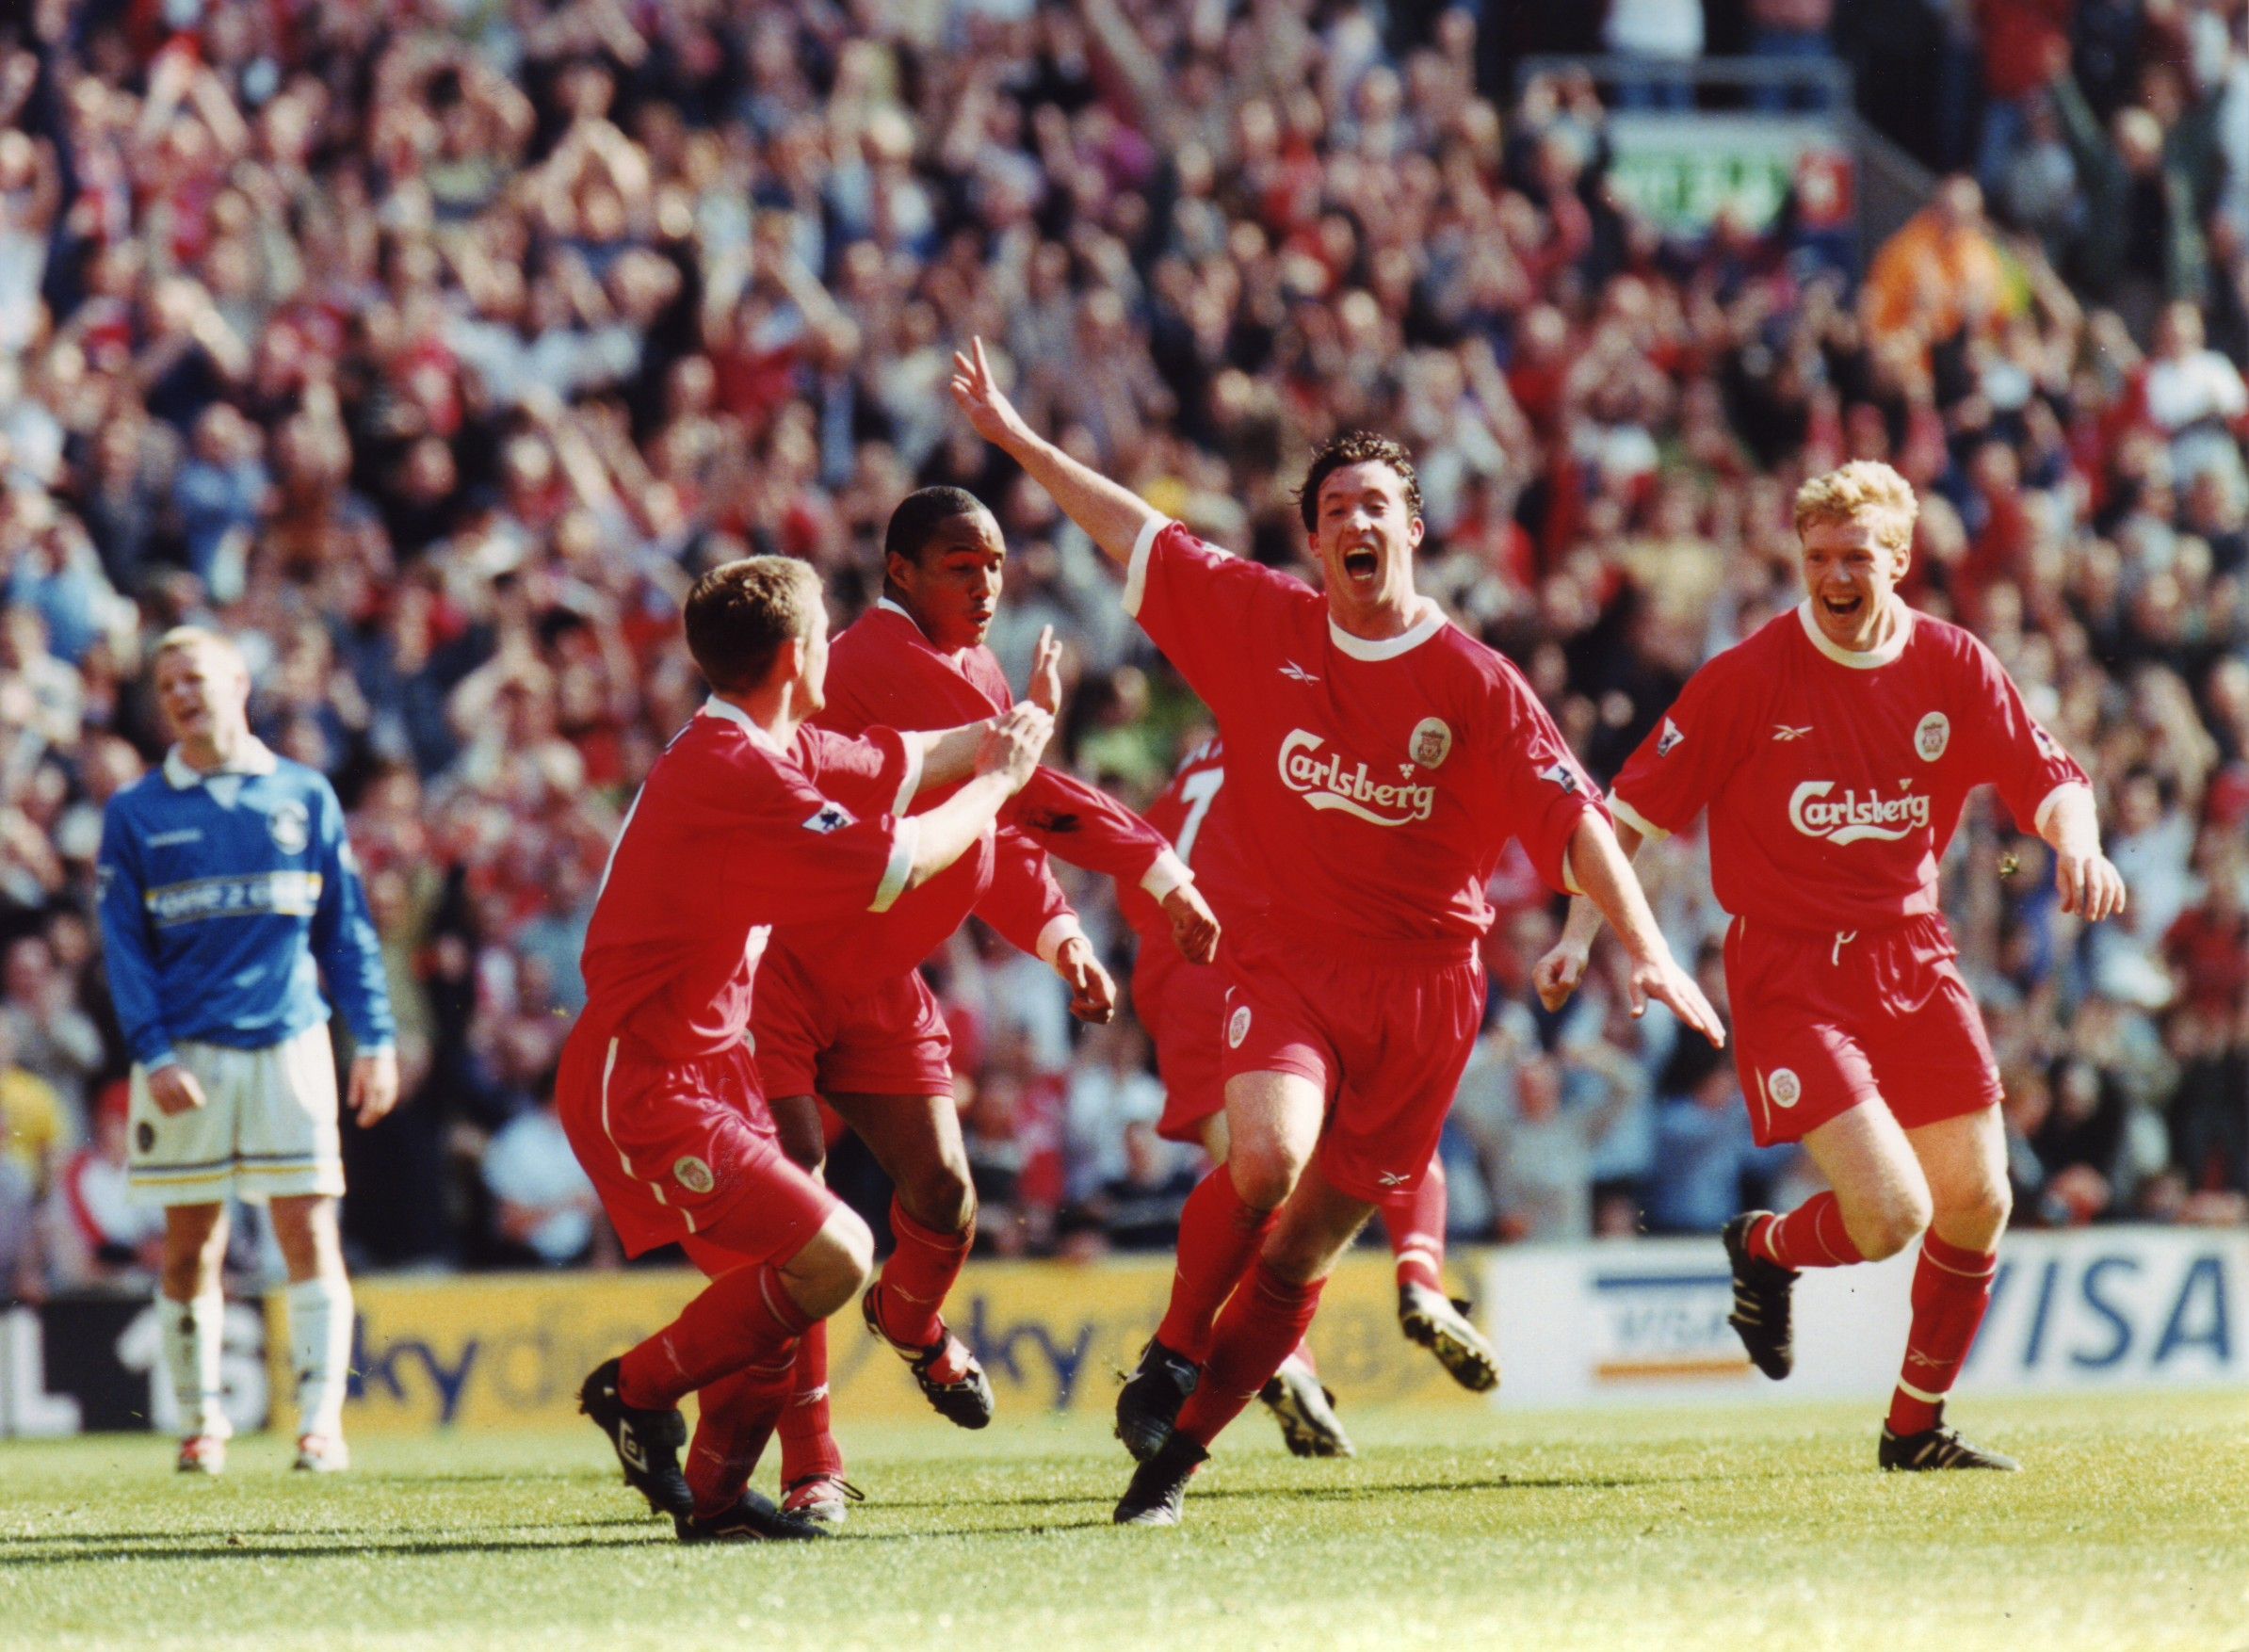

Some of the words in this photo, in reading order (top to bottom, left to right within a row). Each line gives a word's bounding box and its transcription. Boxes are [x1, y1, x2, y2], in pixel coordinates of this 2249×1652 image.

[1174, 767, 1224, 867] 7
[1278, 728, 1435, 823] Carlsberg
[1788, 781, 1930, 841] Carlsberg
